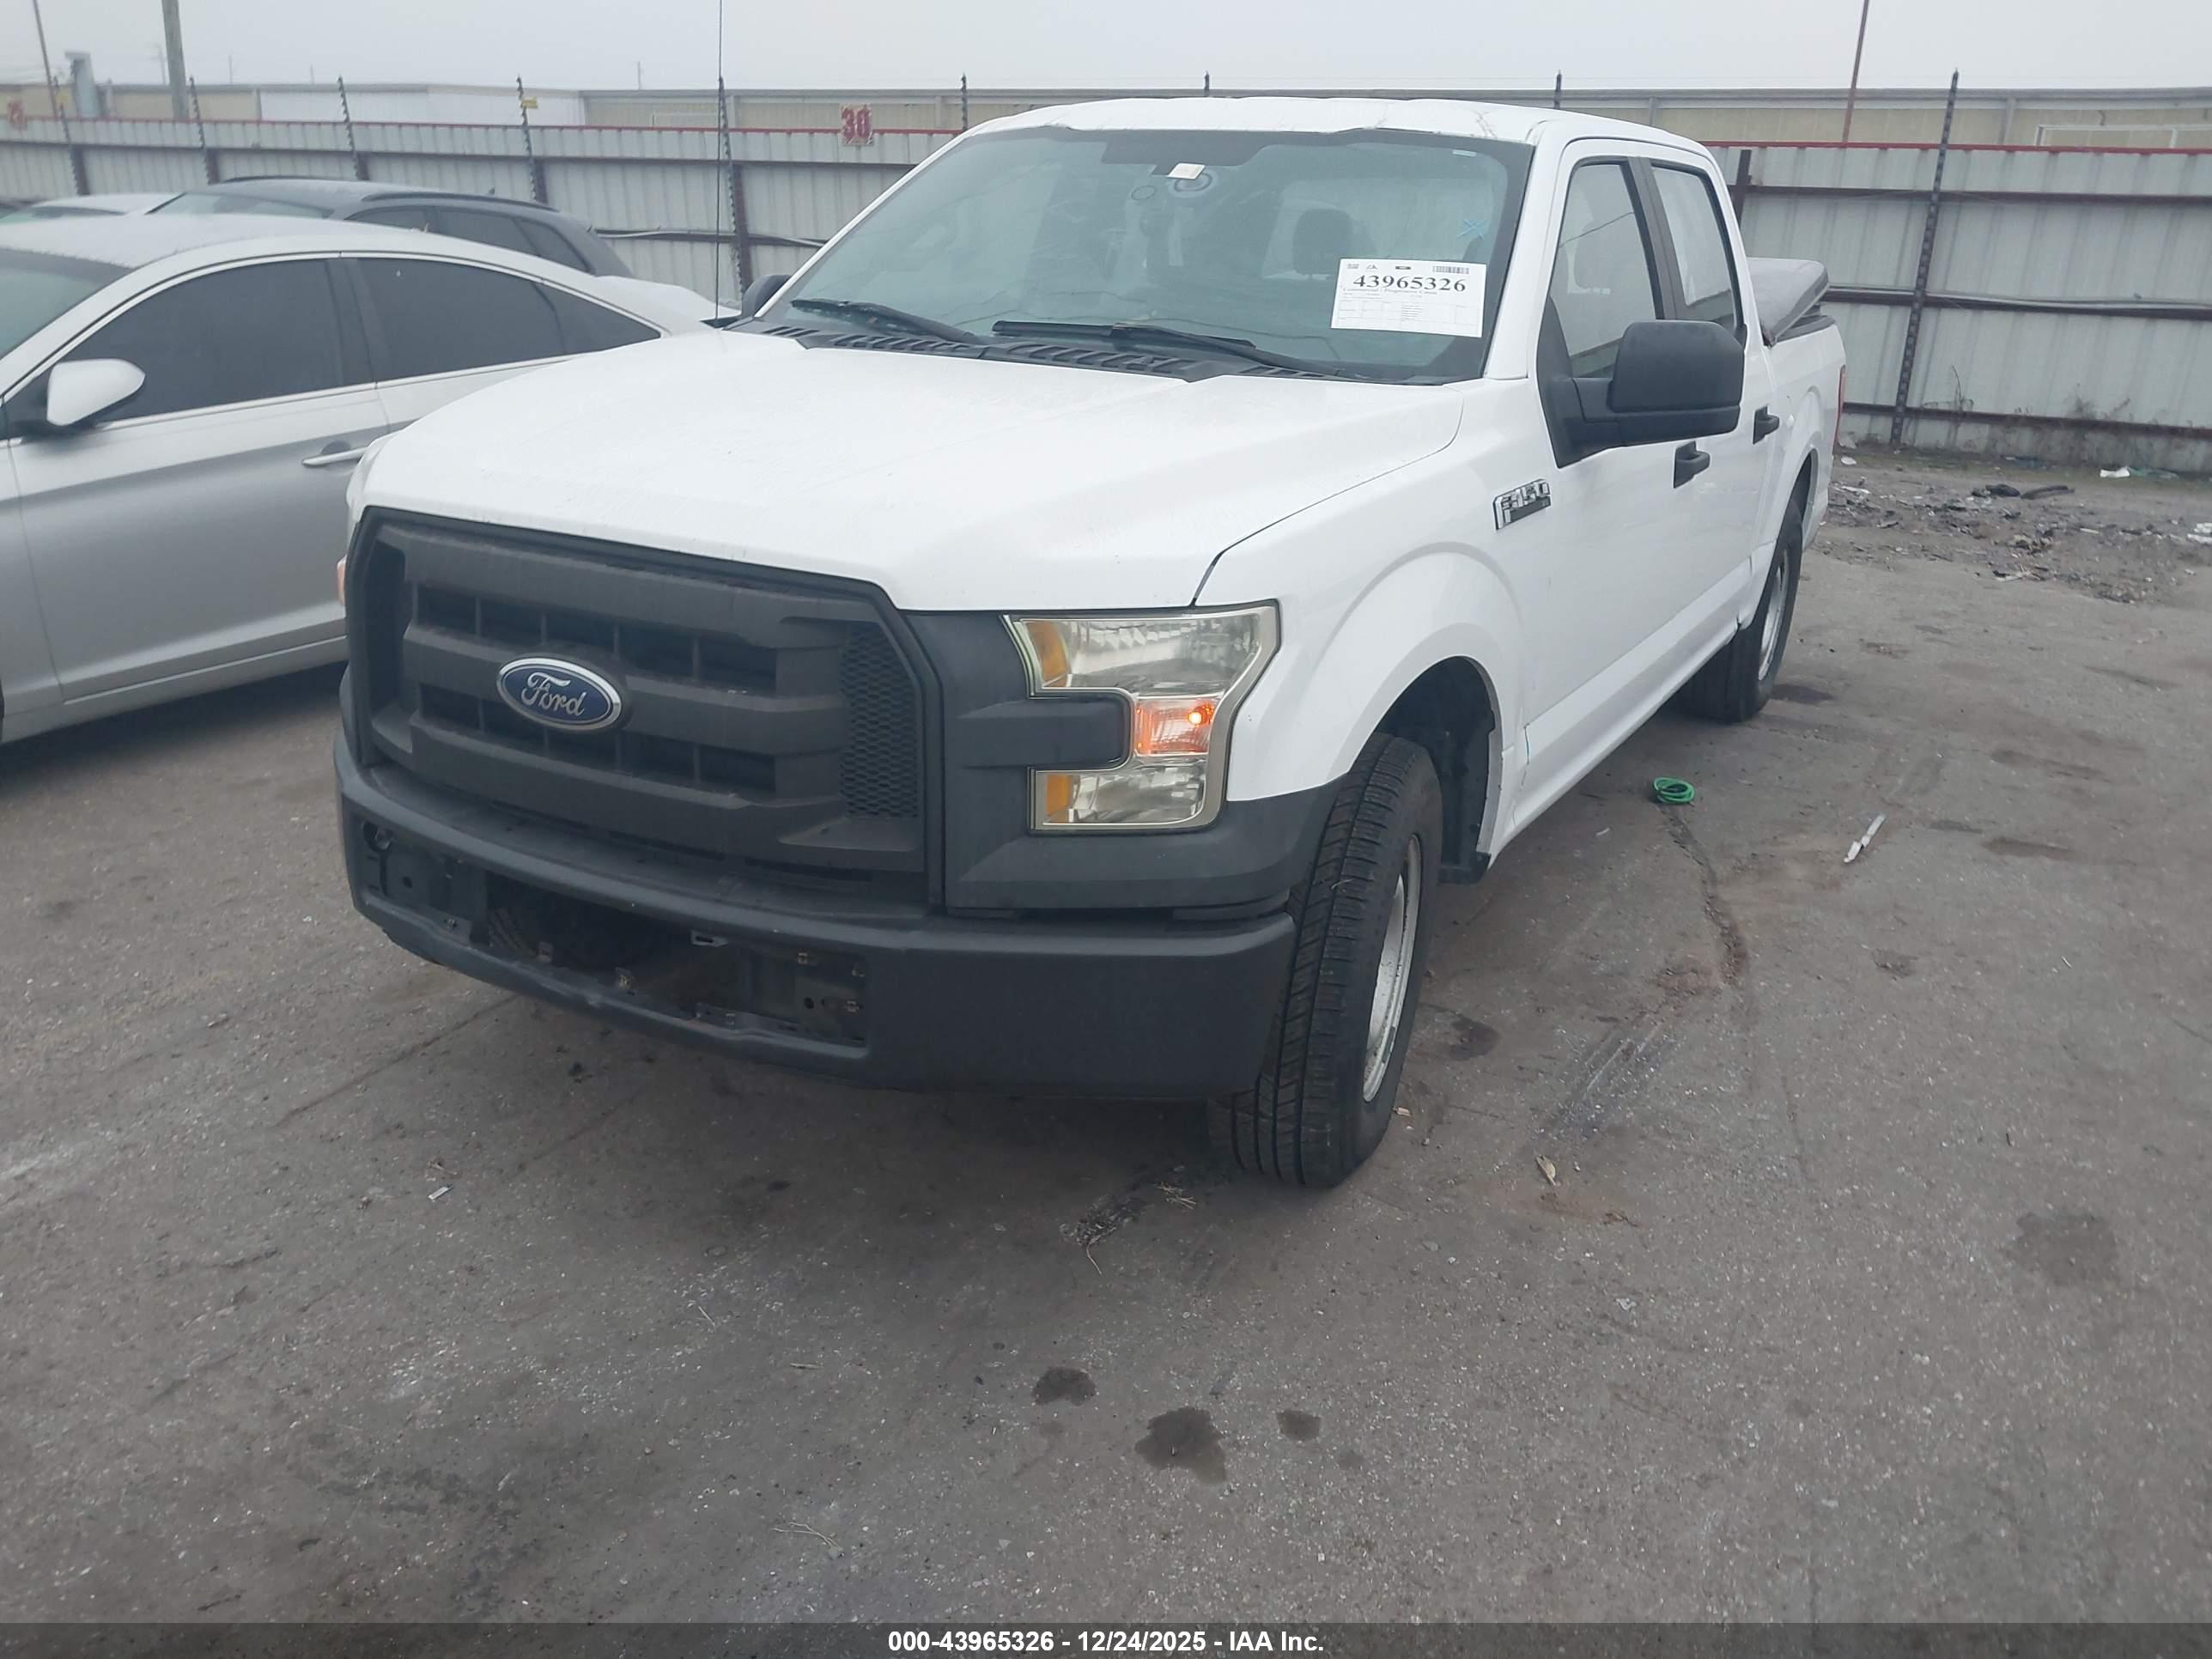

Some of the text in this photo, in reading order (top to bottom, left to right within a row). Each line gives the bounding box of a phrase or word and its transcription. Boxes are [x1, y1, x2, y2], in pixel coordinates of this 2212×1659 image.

[842, 109, 871, 137] 30
[1352, 274, 1467, 293] 43965326
[520, 672, 588, 717] Ford
